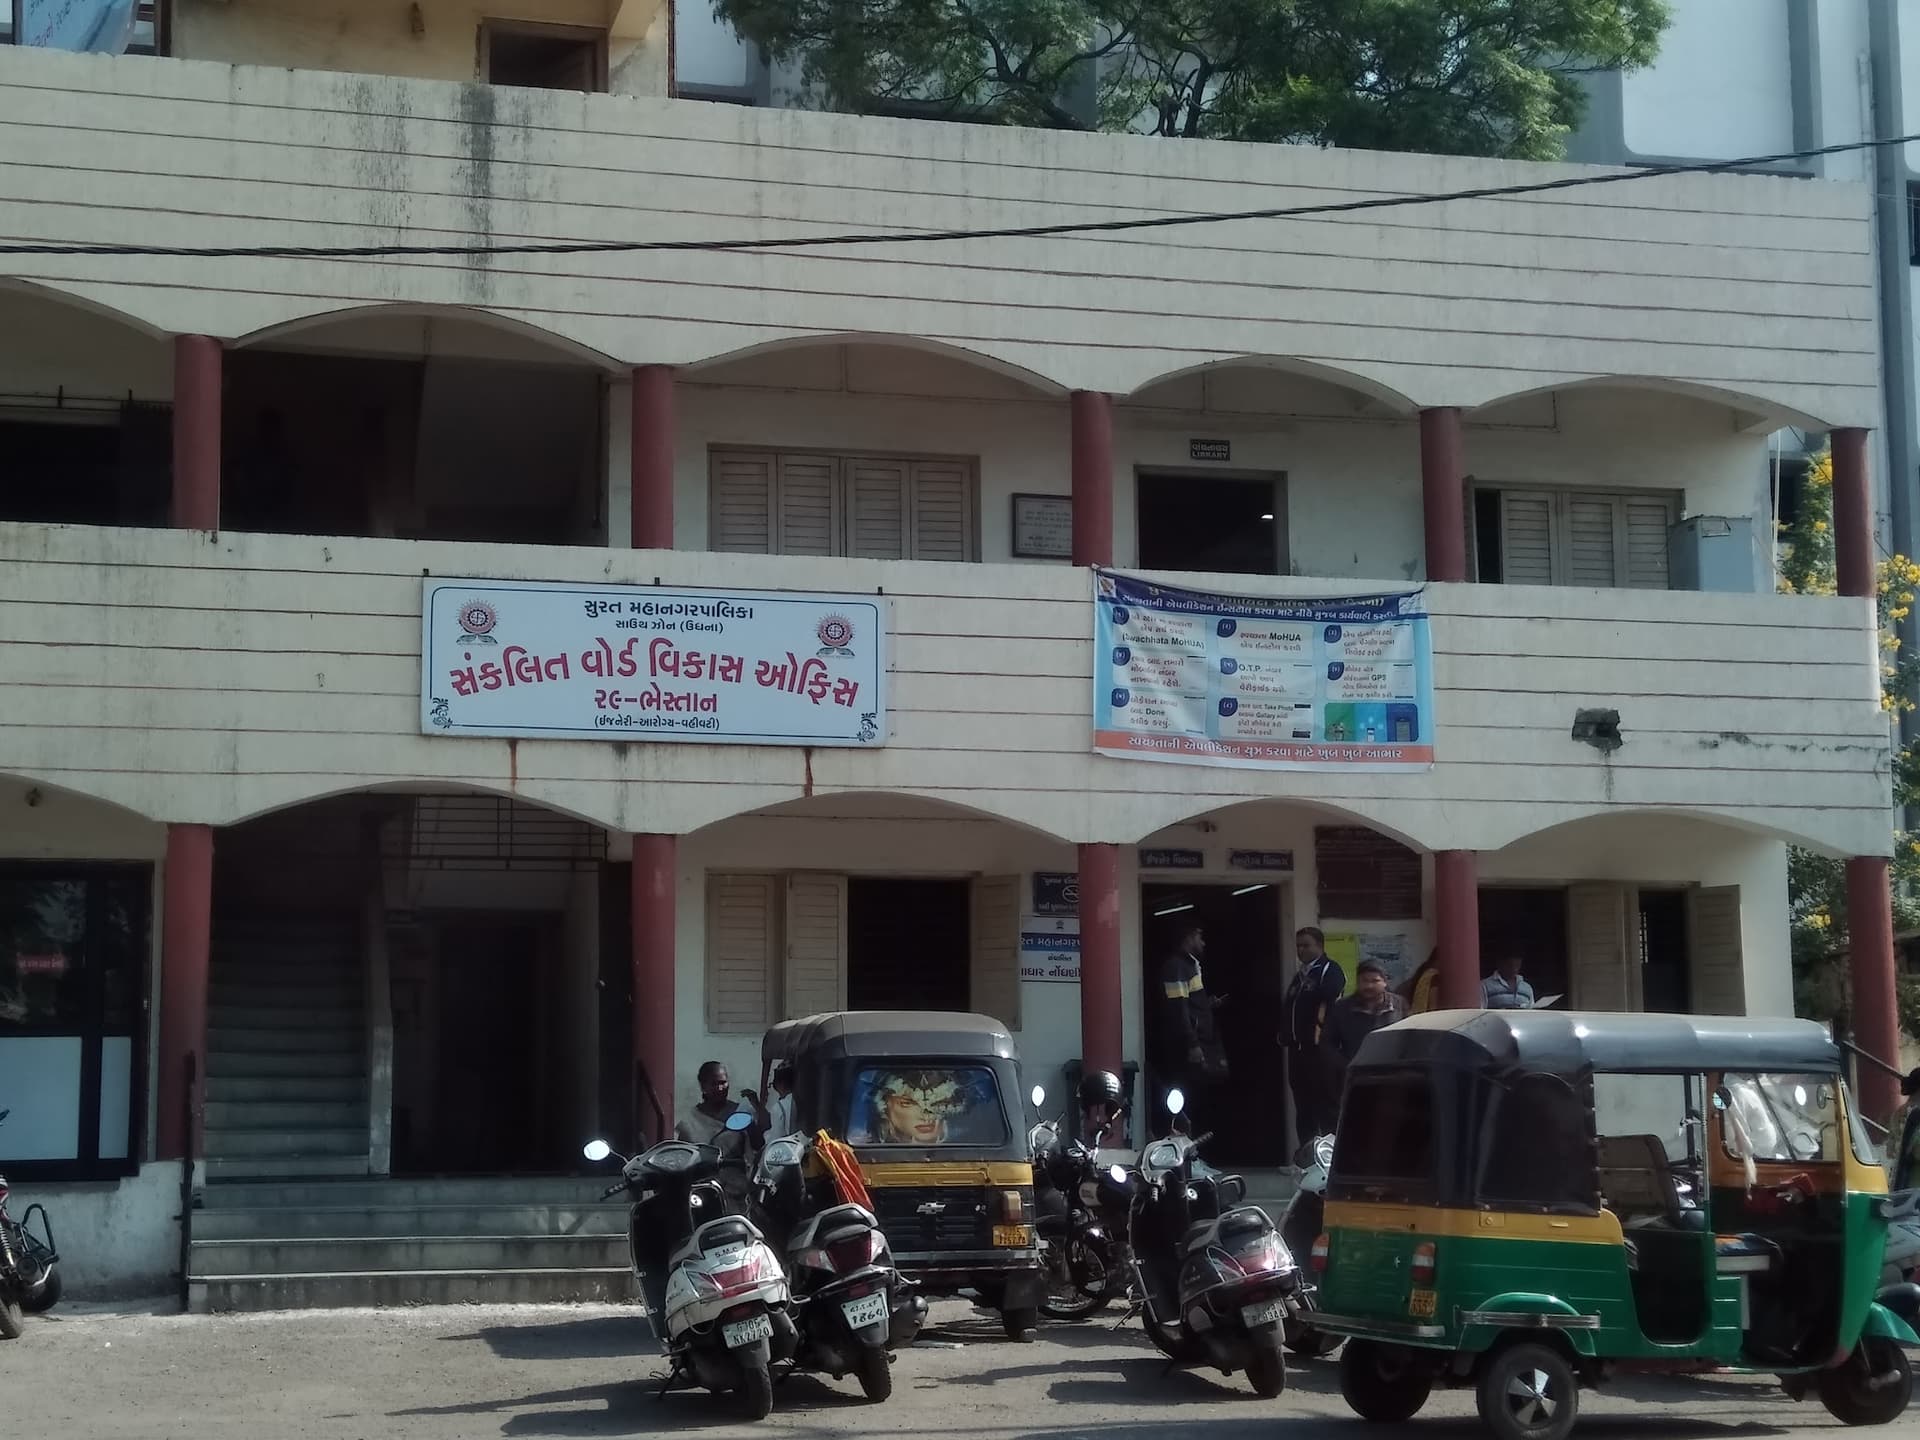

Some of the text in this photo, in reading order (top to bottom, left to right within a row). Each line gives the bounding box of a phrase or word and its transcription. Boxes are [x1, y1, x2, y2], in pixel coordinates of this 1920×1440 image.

[1192, 451, 1228, 460] LIBRARY
[584, 600, 753, 619] સુરત મહાનગરપાલિકા
[615, 618, 724, 633] સાઉથ ઝોન (ઉધના)
[1269, 632, 1301, 641] MoHUA
[450, 637, 859, 707] સંકલિત વોર્ડ વિકાસ ઓફિસ
[1145, 707, 1165, 716] Done
[1266, 747, 1291, 757] કરવા
[1294, 746, 1314, 757] માટે
[1366, 749, 1402, 759] આભાર
